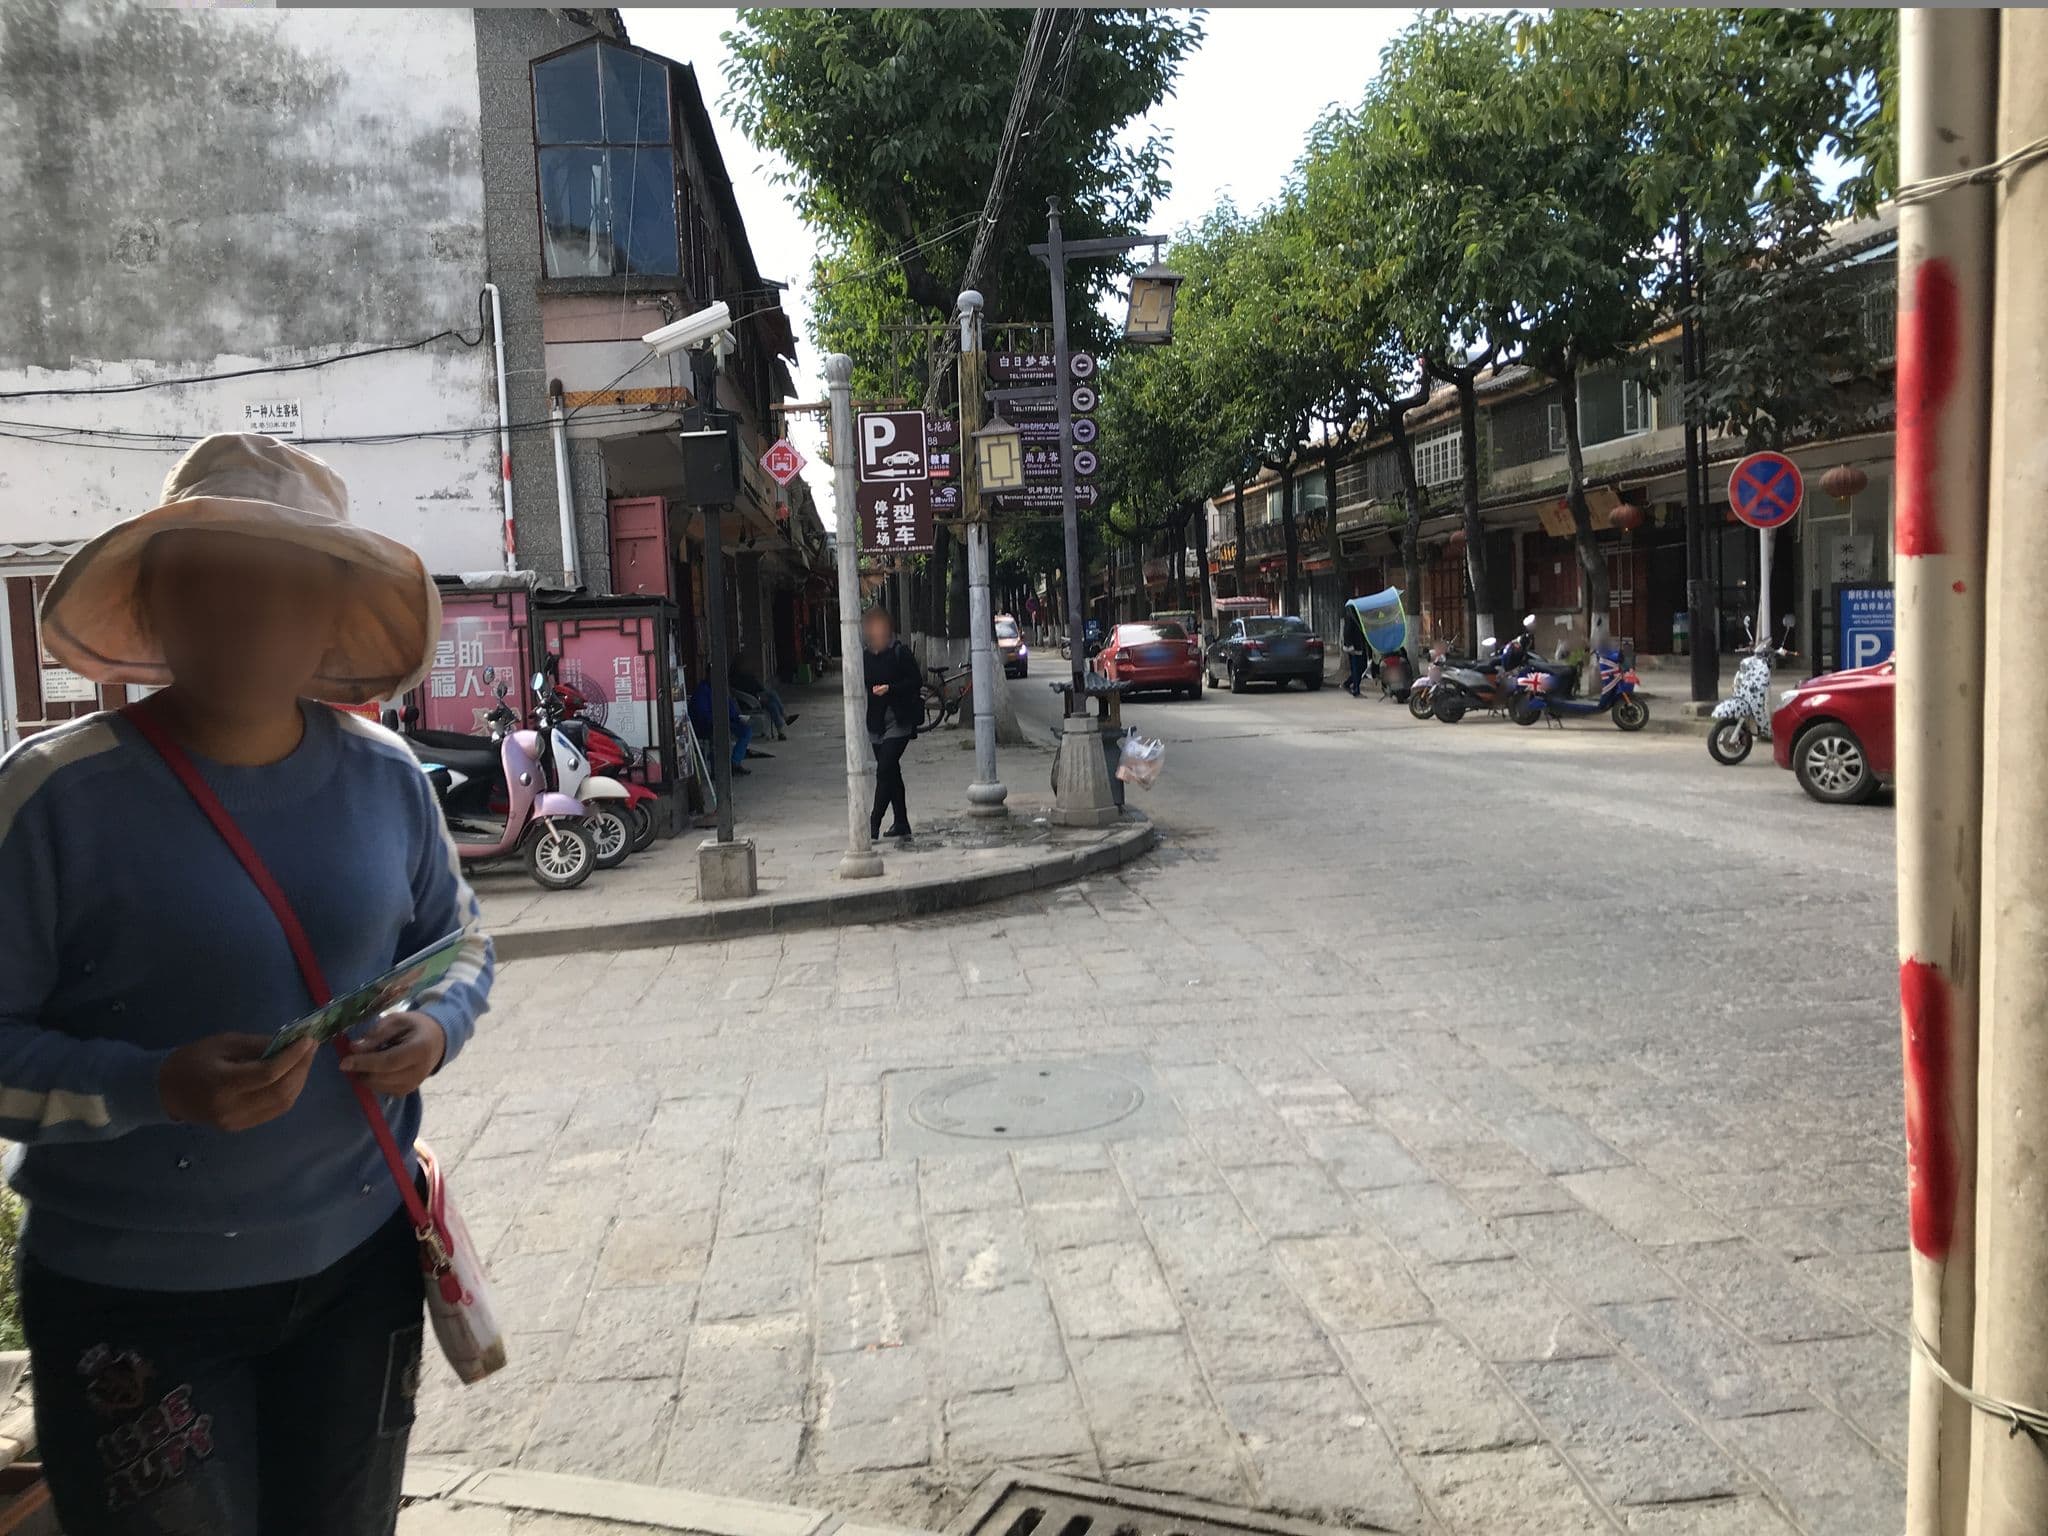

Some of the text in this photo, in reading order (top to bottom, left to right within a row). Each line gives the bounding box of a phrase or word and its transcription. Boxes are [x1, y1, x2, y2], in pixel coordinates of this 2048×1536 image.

[245, 403, 299, 418] 另一种人生客栈
[864, 417, 896, 465] P
[874, 500, 890, 546] 停车场
[892, 482, 916, 545] 小型车
[1855, 634, 1881, 669] P
